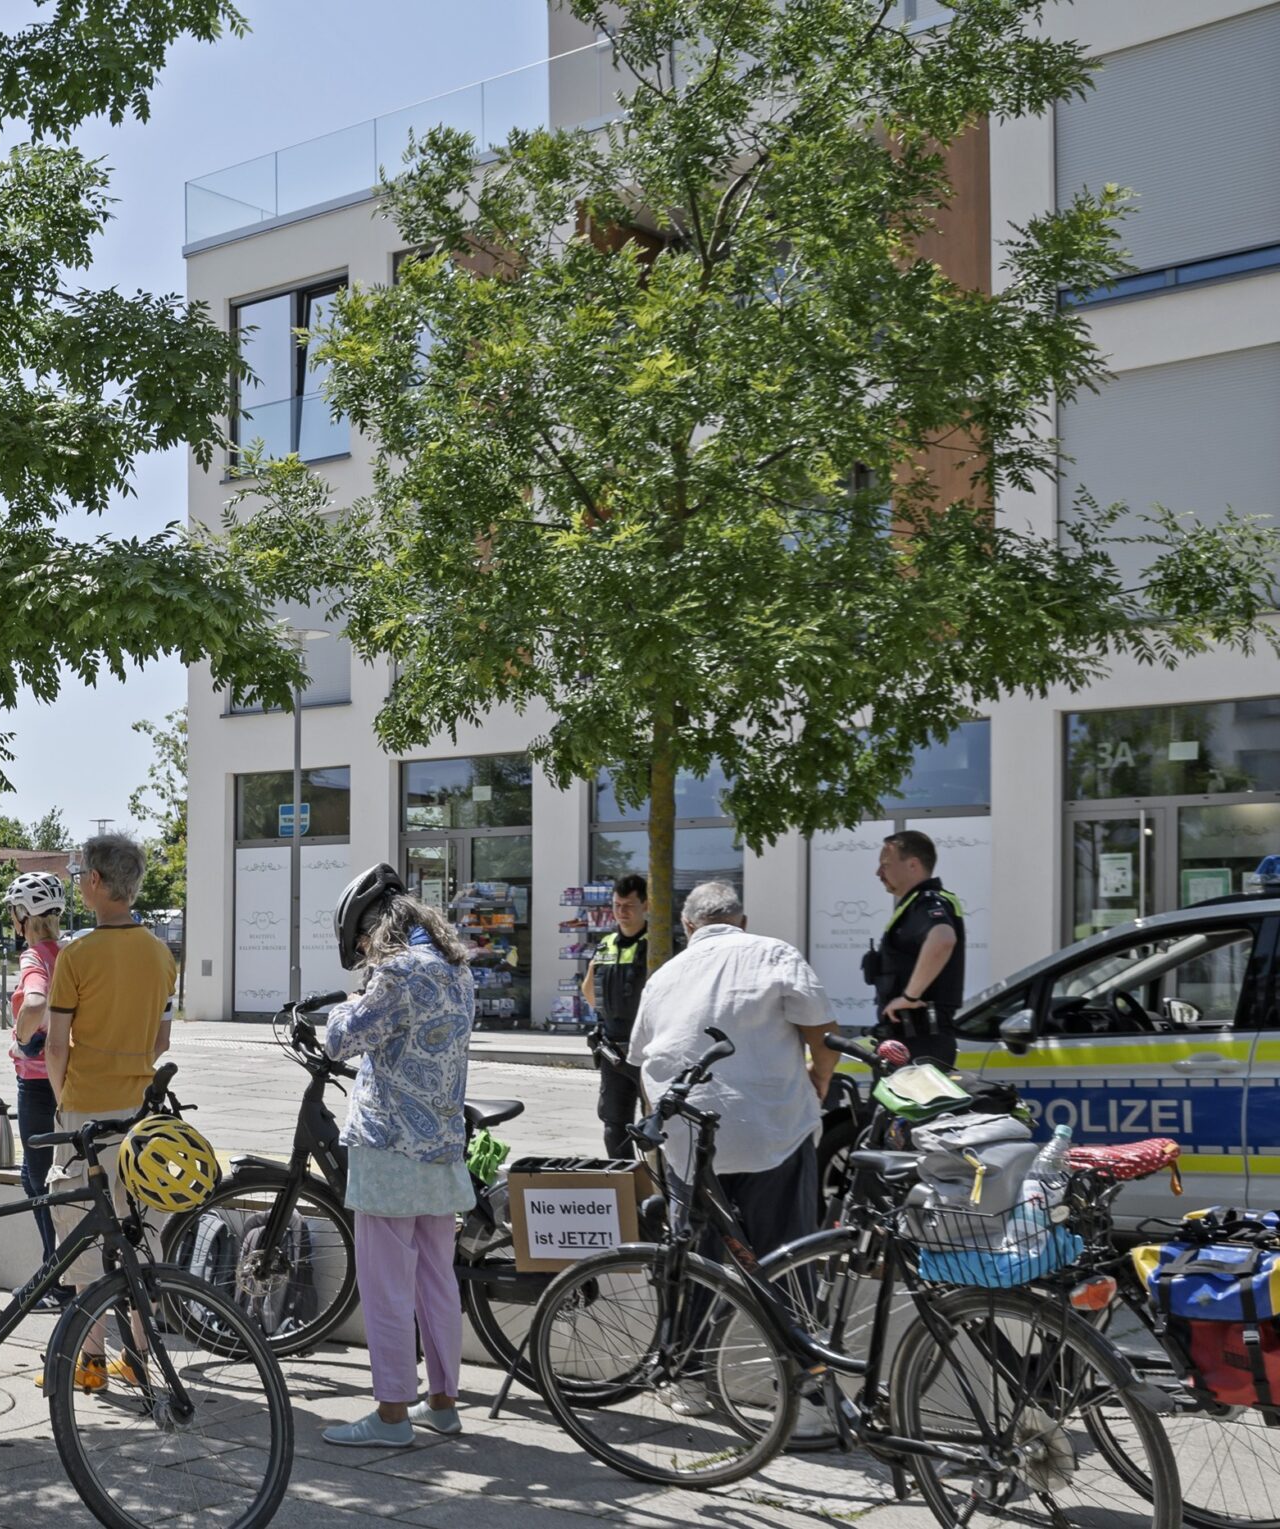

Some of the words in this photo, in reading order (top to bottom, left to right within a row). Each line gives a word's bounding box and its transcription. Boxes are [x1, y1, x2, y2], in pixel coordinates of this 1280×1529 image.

[1097, 741, 1136, 769] 3A
[530, 1201, 555, 1214] Nie
[559, 1201, 612, 1214] wieder
[534, 1231, 554, 1245] ist
[558, 1232, 613, 1246] JETZT!
